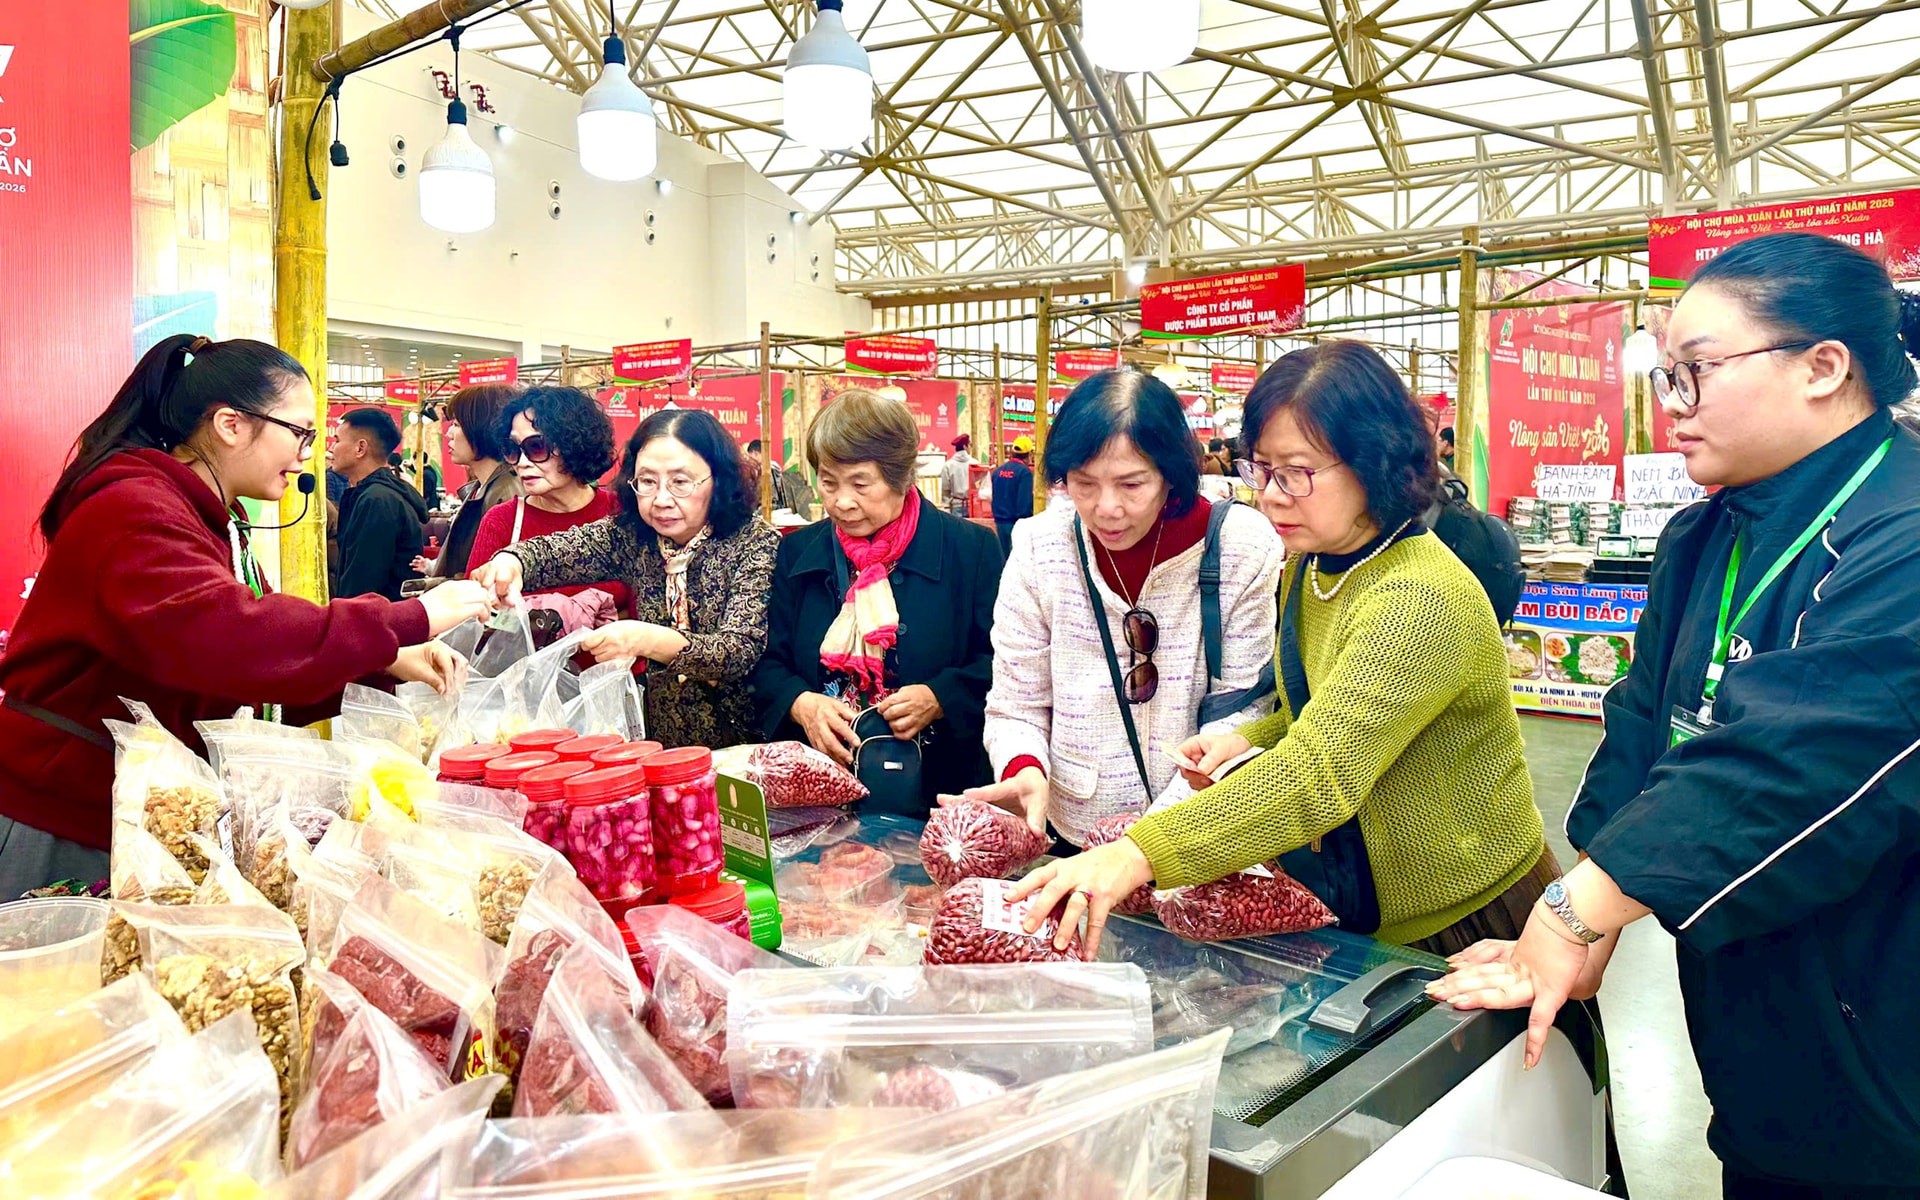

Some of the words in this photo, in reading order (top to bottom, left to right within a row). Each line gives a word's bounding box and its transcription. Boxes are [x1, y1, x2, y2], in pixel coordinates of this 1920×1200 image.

[1686, 219, 1702, 231] HỘI
[1703, 216, 1723, 229] CHỢ
[1724, 212, 1745, 225] MÙA
[1746, 209, 1773, 223] XUÂN
[1774, 206, 1793, 221] LẦN
[1795, 204, 1815, 217] THỨ
[1816, 202, 1842, 215] NHẤT
[1843, 199, 1868, 212] NĂM
[1869, 197, 1895, 209] 2026
[1695, 246, 1720, 261] HTX
[1864, 228, 1885, 245] HÀ
[1186, 301, 1207, 316] CÔNG
[1208, 301, 1218, 314] TY
[1219, 299, 1230, 313] CỔ
[1231, 296, 1253, 311] PHẦN
[1185, 313, 1208, 330] PHẨM
[1209, 314, 1238, 328] TAKICHI
[1238, 310, 1256, 325] VIỆT
[1257, 310, 1277, 322] NAM
[1522, 343, 1539, 379] HỘI
[1540, 350, 1558, 381] CHỢ
[1559, 350, 1578, 379] MÙA
[1579, 353, 1600, 381] XUÂN
[719, 406, 748, 425] XUÂN
[1509, 418, 1541, 456] Nông
[1541, 425, 1559, 448] sản
[1559, 421, 1581, 454] Việt
[1631, 467, 1661, 482] NEM
[1672, 485, 1706, 500] NINH
[1546, 602, 1579, 619] BÙI
[1586, 602, 1626, 622] BẮC
